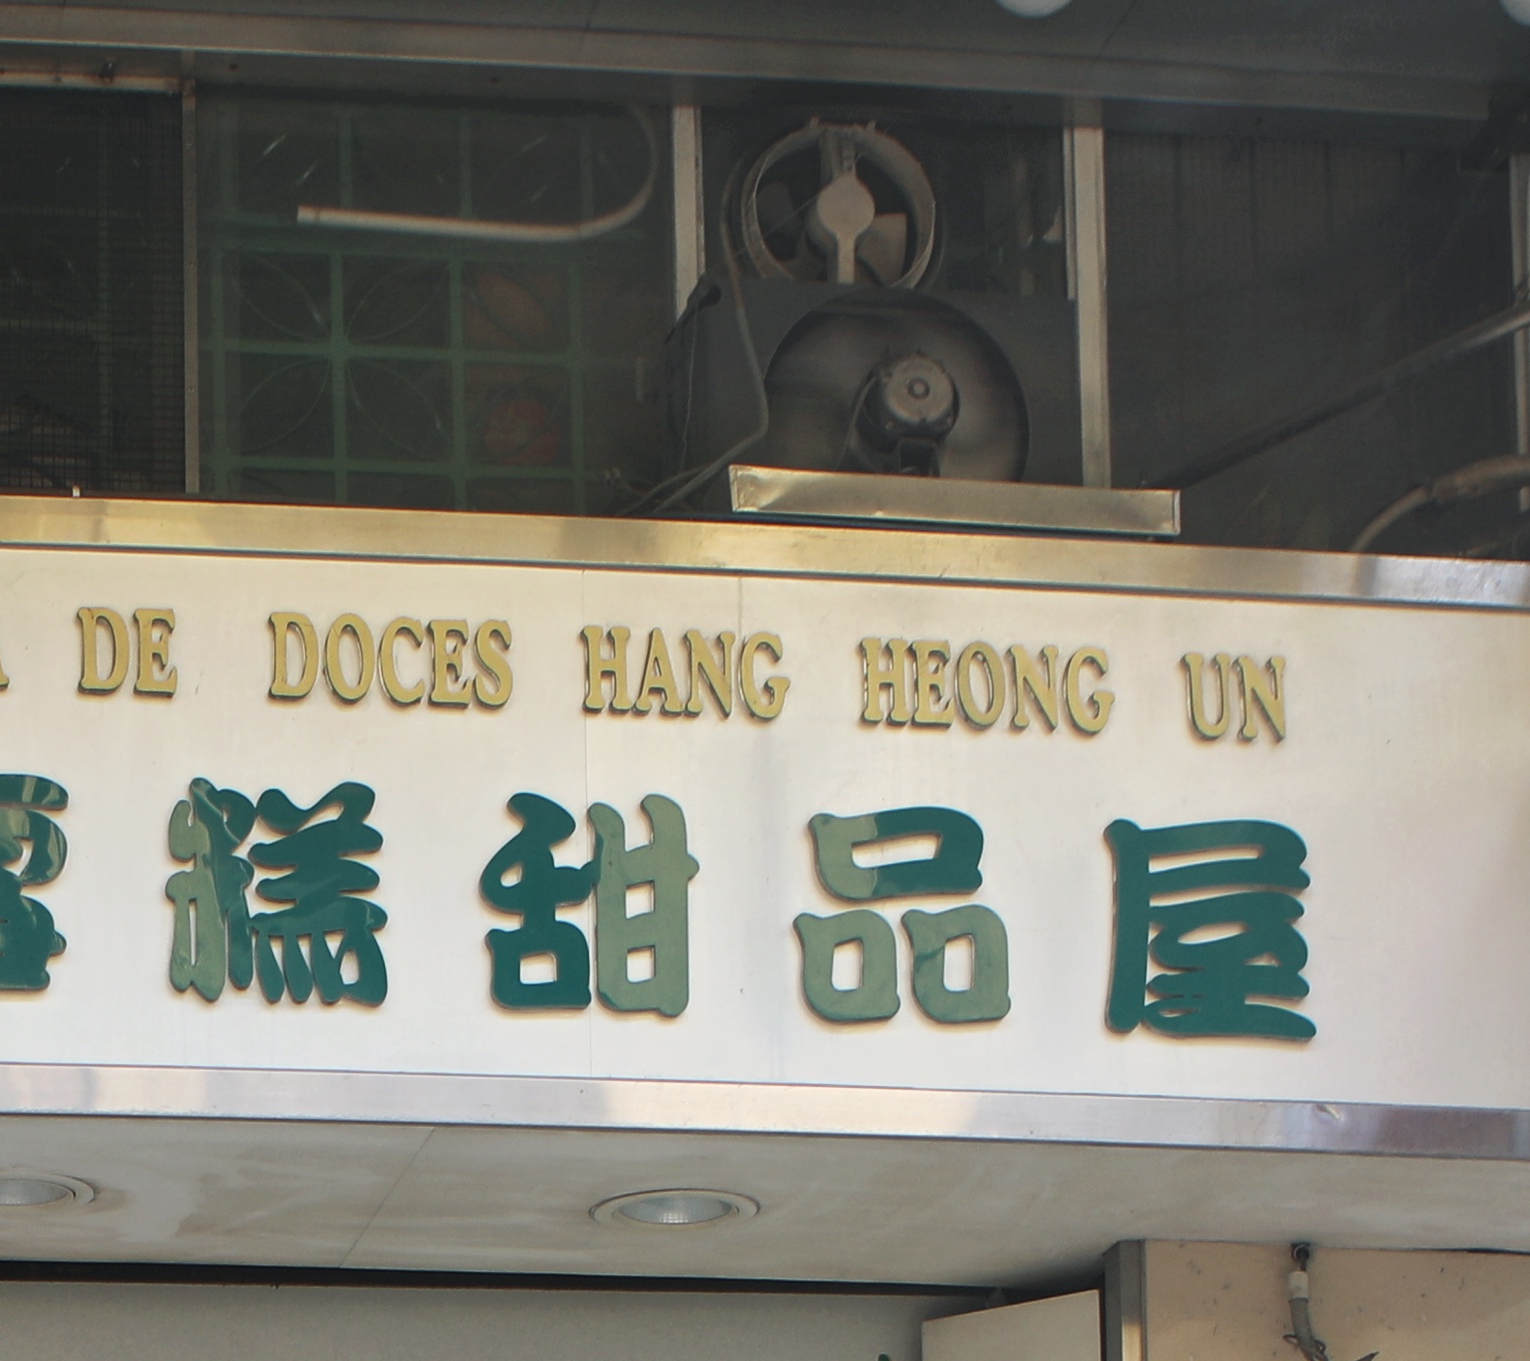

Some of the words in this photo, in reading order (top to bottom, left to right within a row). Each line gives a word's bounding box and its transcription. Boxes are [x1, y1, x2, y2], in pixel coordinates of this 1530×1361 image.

[75, 603, 179, 698] DE
[267, 610, 514, 708] DOCES
[581, 624, 790, 724] HANG
[859, 634, 1112, 738] HEONG
[1180, 649, 1288, 746] UN
